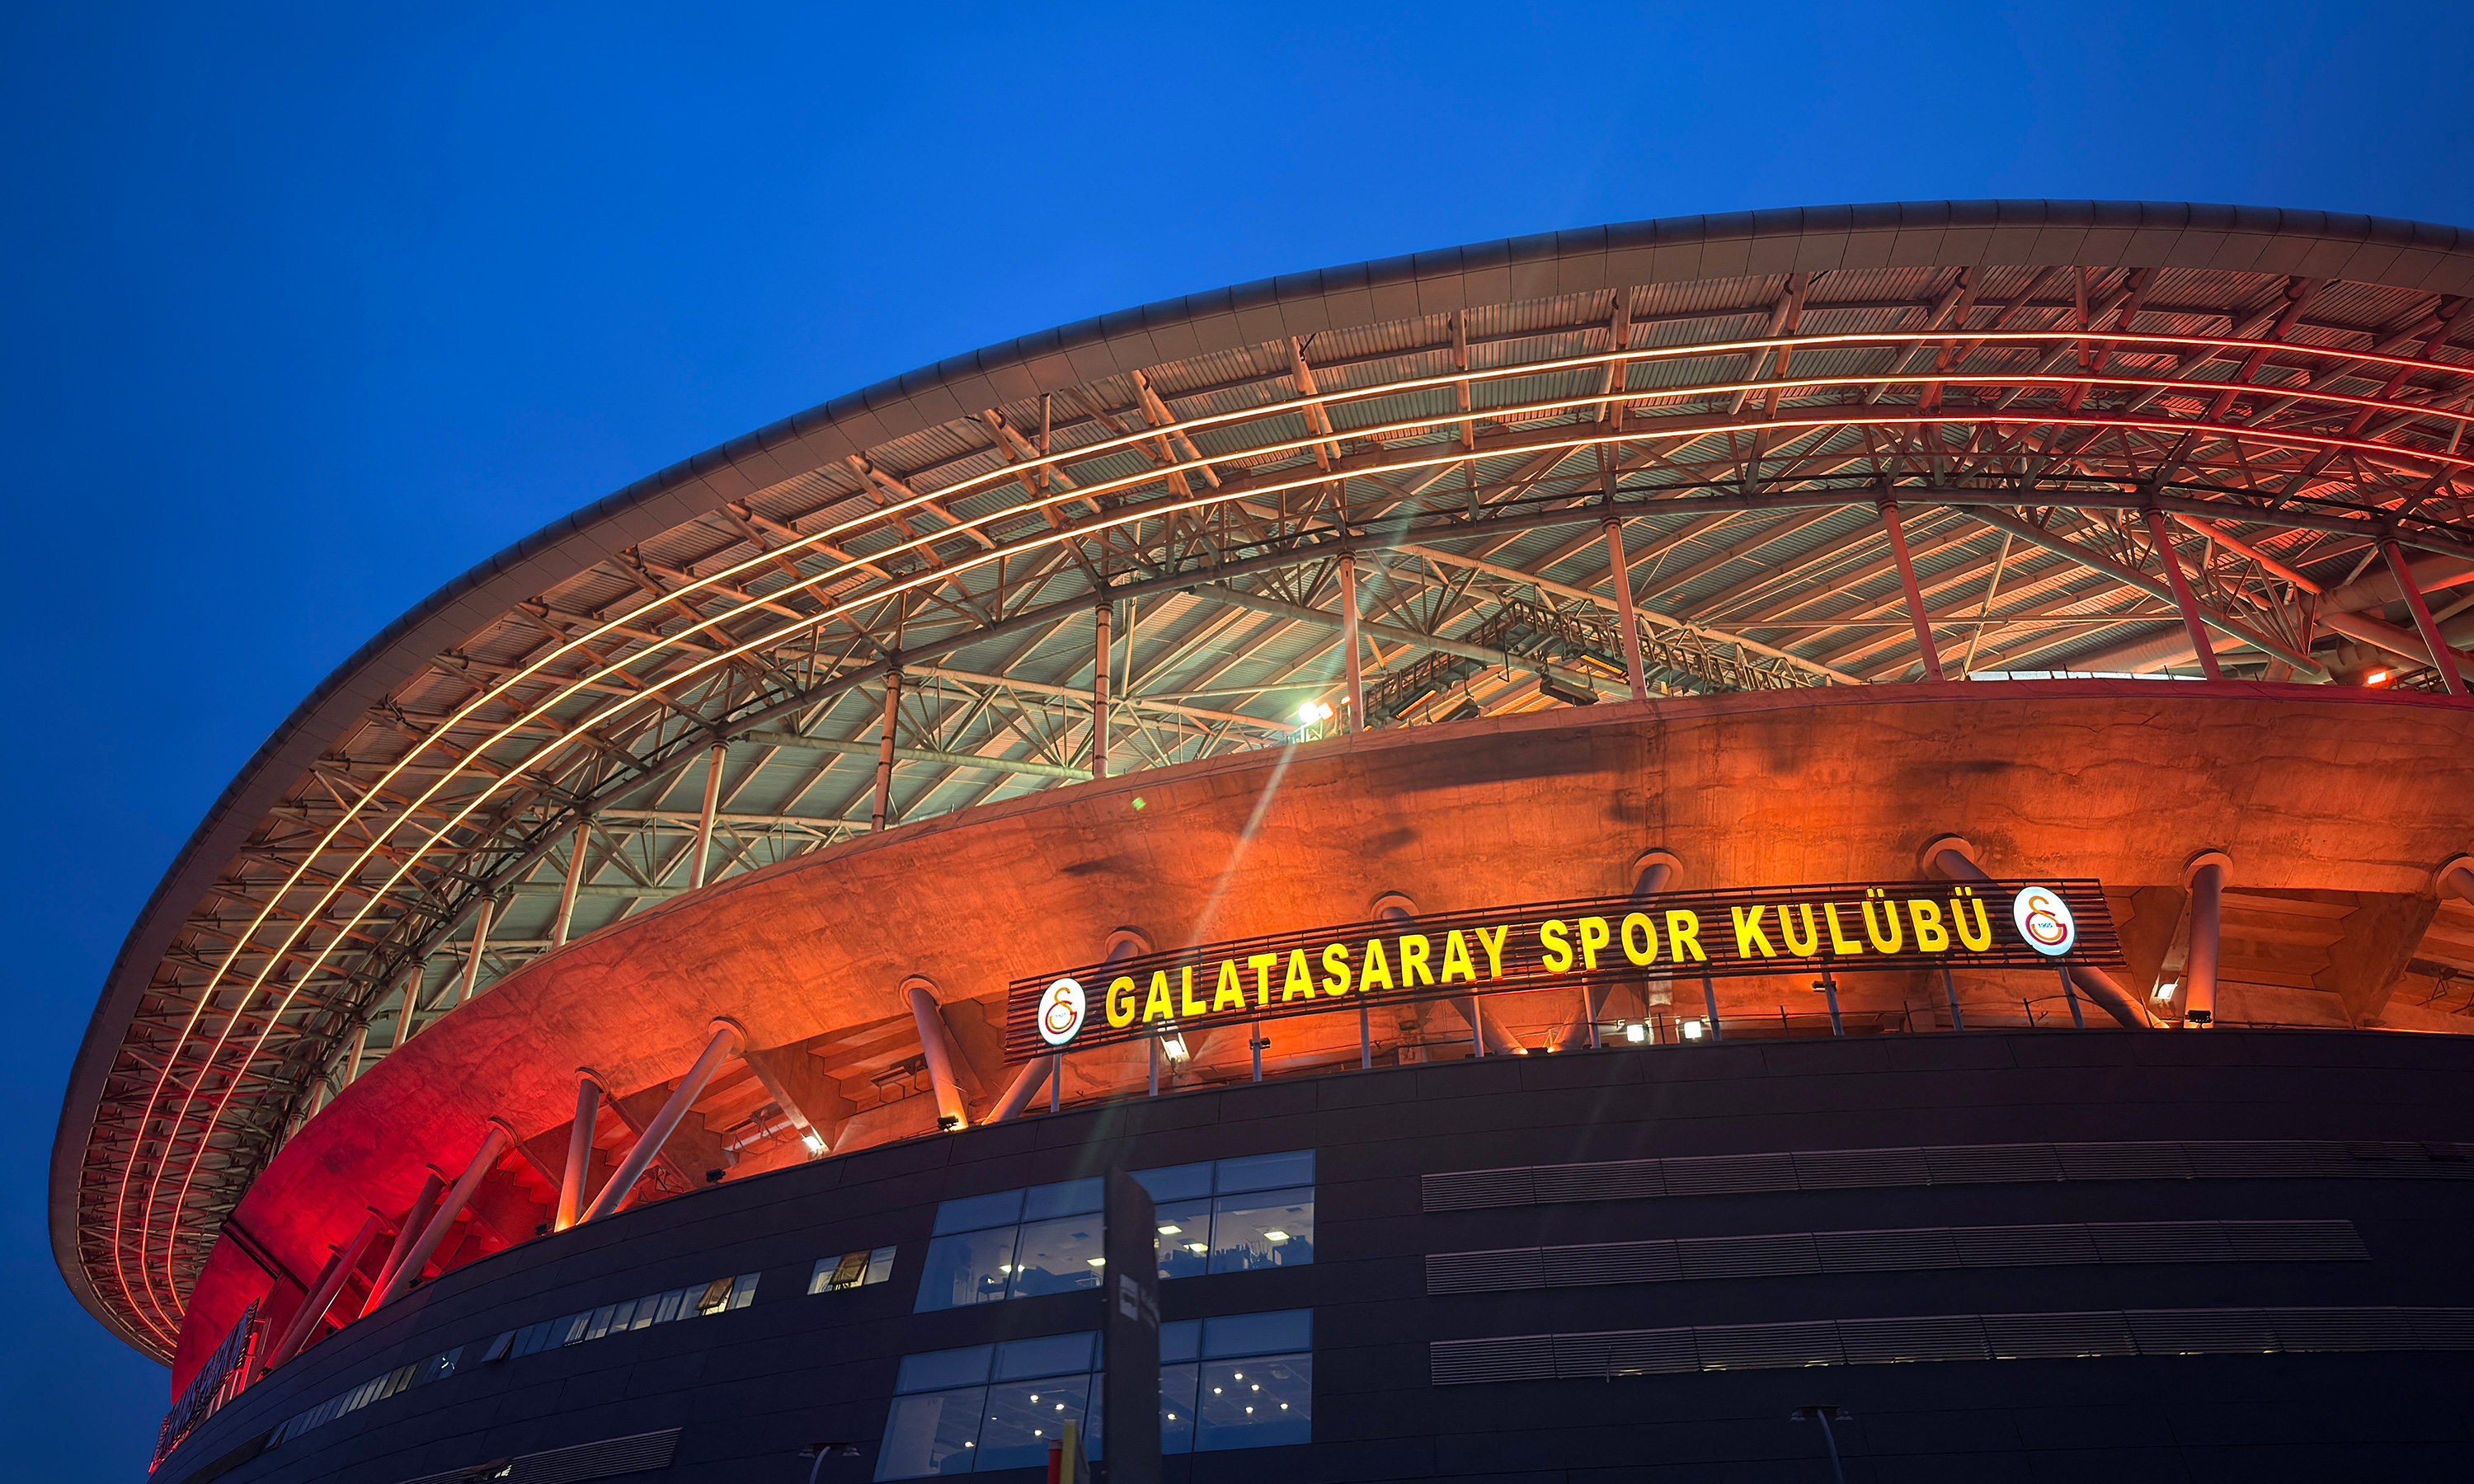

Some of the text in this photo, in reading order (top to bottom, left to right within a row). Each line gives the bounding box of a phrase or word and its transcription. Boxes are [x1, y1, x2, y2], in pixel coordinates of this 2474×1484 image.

[1105, 886, 1992, 1029] GALATASARAY SPOR KULÜBÜ
